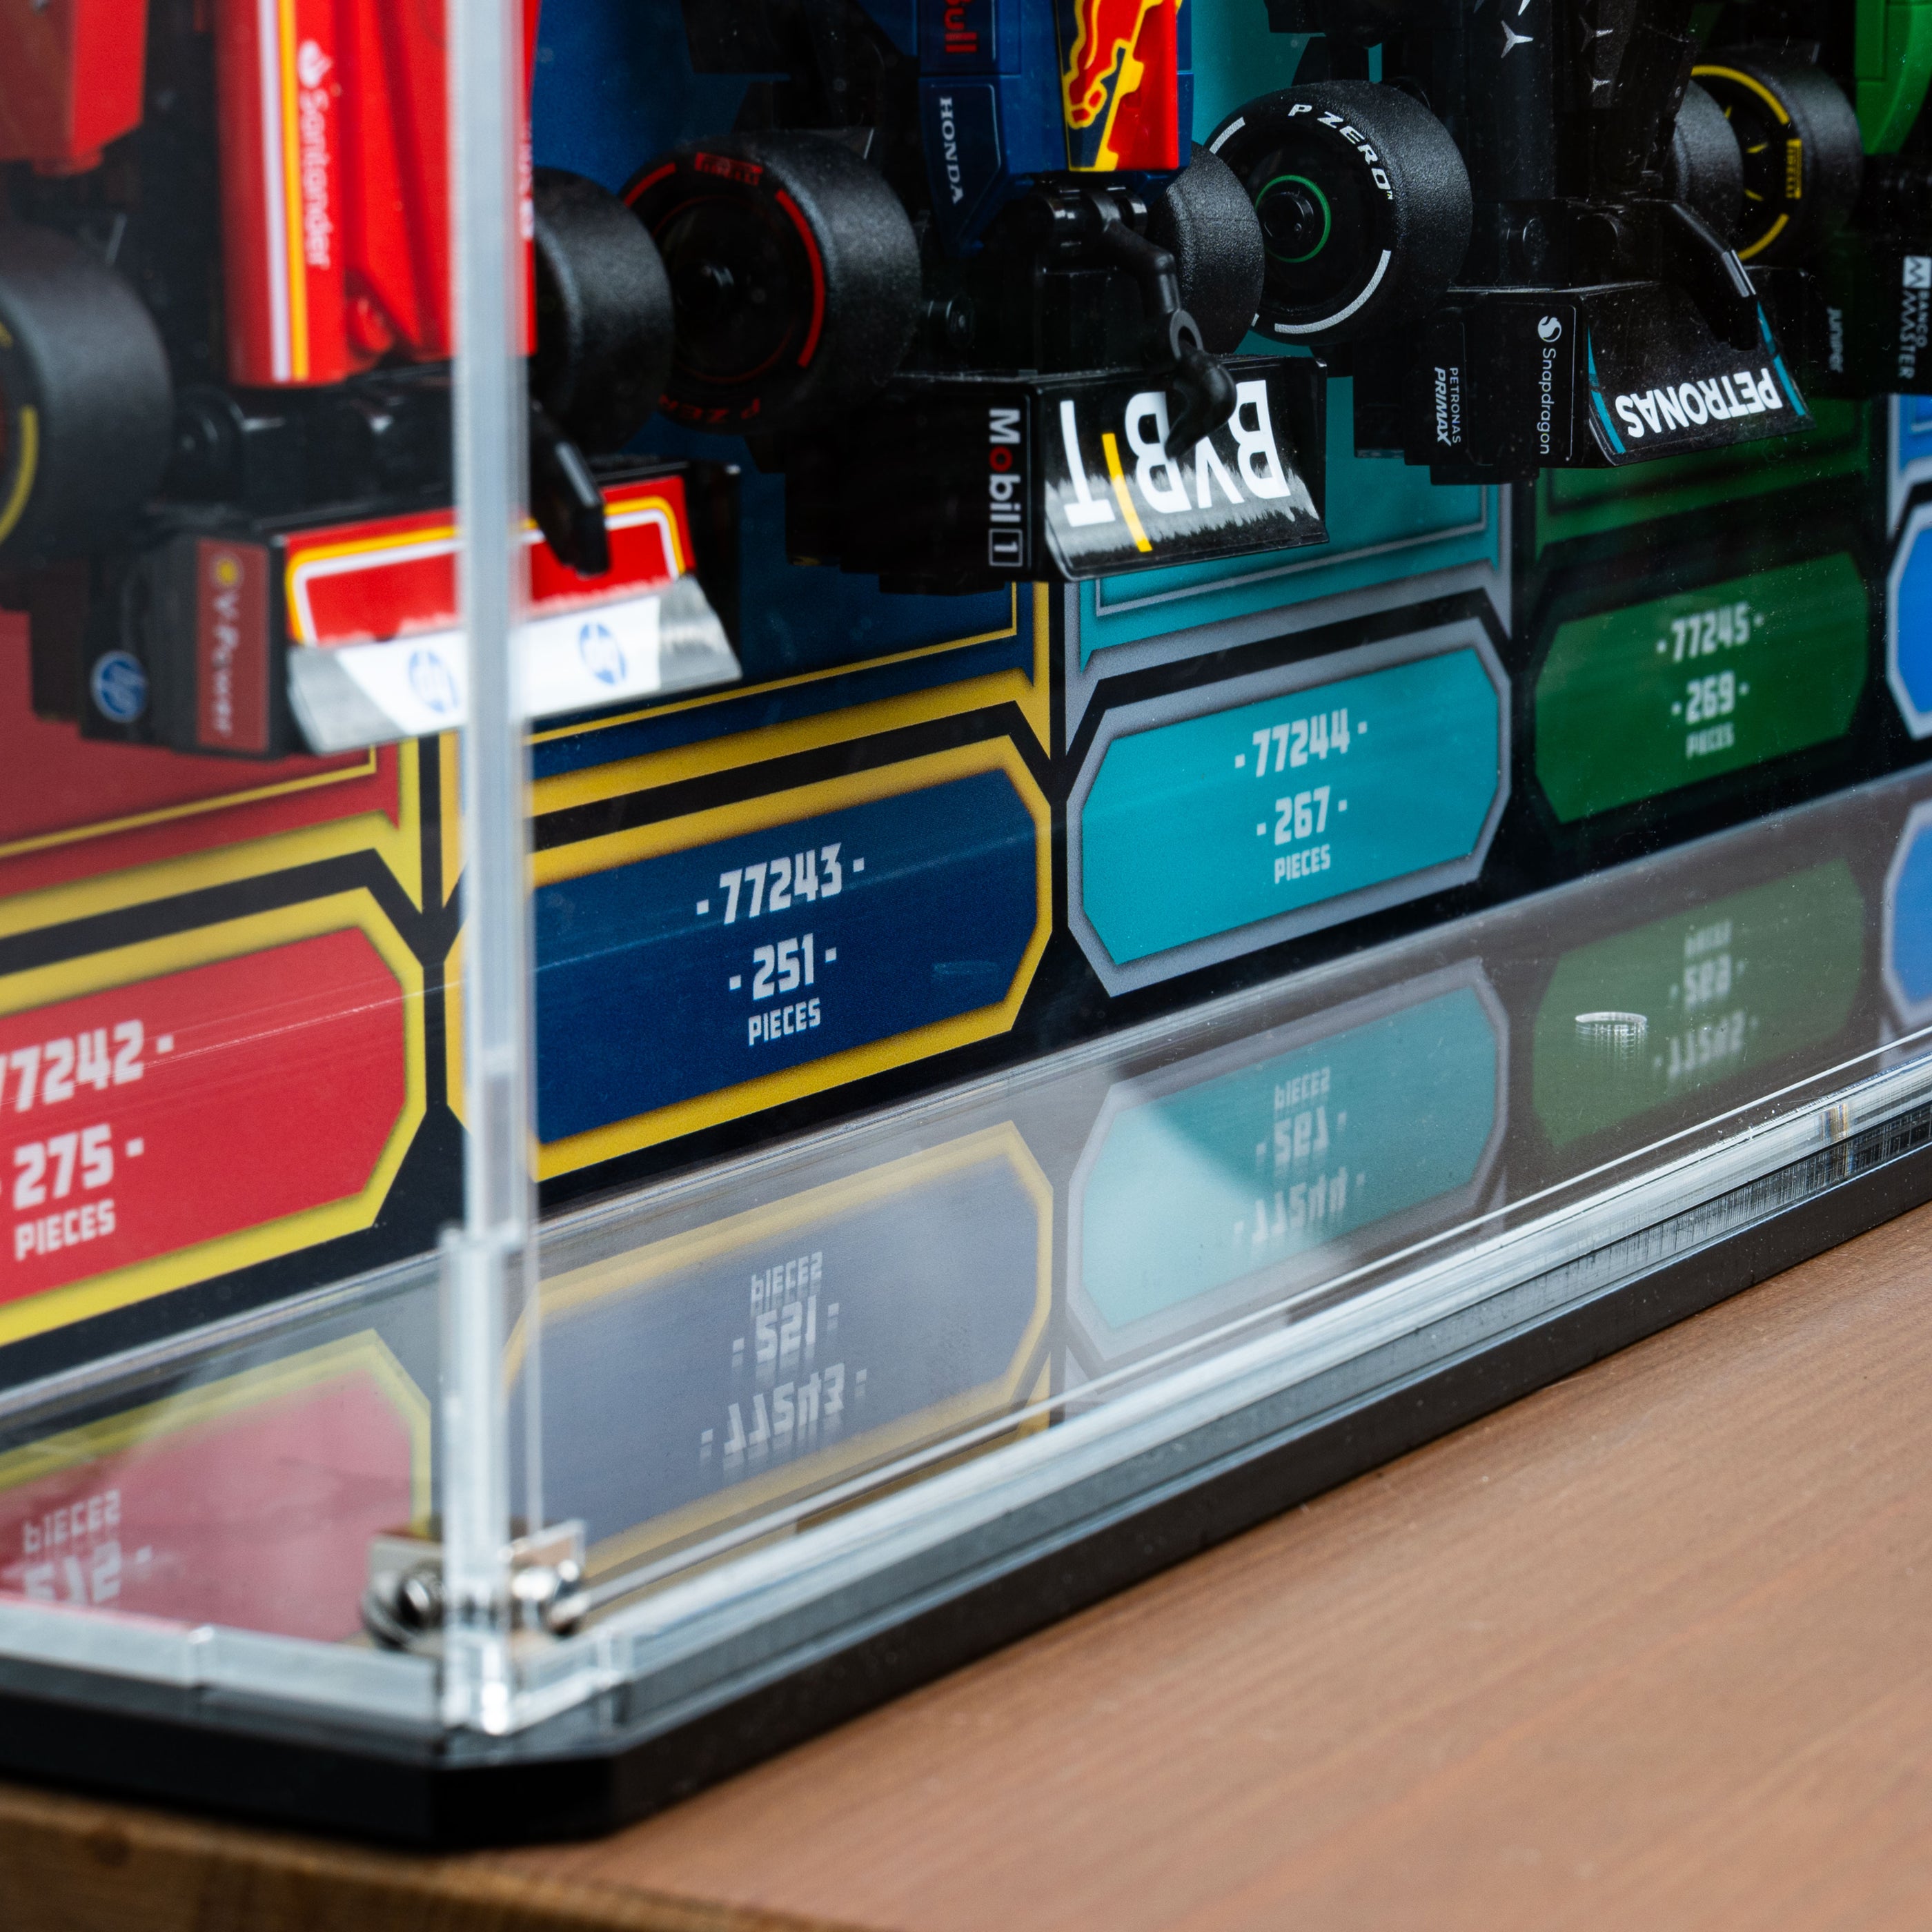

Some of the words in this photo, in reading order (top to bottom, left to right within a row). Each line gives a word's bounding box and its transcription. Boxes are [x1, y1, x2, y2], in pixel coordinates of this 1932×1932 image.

[1288, 103, 1312, 117] P
[299, 89, 333, 269] Santander
[940, 97, 963, 204] HONDA
[1434, 366, 1452, 446] PRIMAX
[1449, 367, 1461, 444] PETRONAS
[1537, 348, 1557, 455] Snapdragon
[1615, 367, 1784, 439] PETRONAS
[989, 408, 1021, 522] Mobil
[1670, 602, 1751, 663] 77245
[1686, 670, 1735, 725] 269
[1252, 707, 1350, 778] 77244
[1274, 785, 1331, 845] 267
[719, 842, 842, 925] 77243
[1274, 844, 1331, 885] PIECES
[752, 933, 814, 1000] 251
[748, 997, 821, 1046] PIECES
[13, 1124, 114, 1210] 275
[15, 1199, 116, 1261] PIECES
